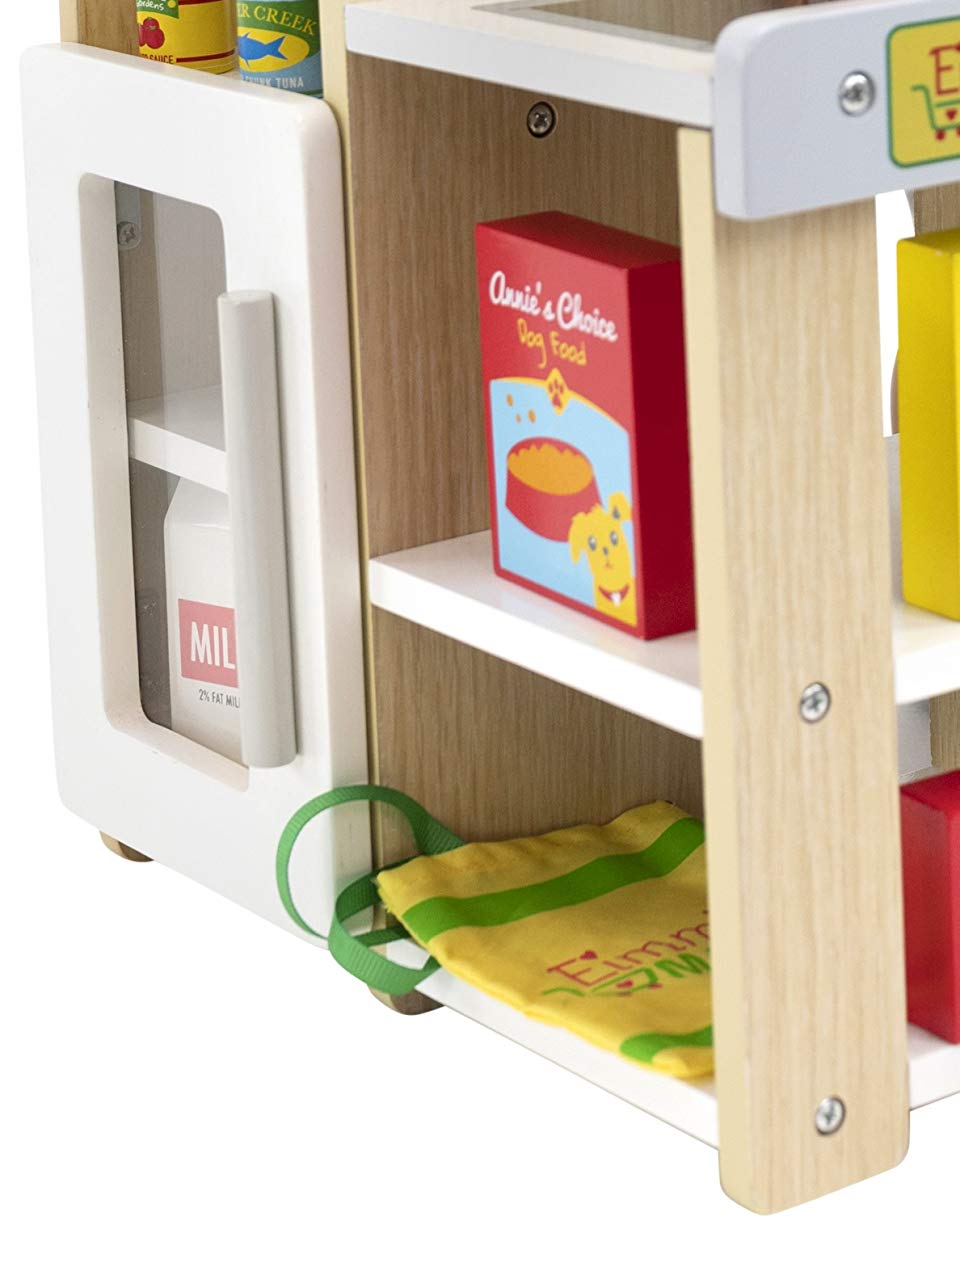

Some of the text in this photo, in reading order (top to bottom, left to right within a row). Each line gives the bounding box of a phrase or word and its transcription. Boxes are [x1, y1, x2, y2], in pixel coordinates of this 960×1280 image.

[254, 5, 317, 36] CREEK
[275, 76, 304, 89] TUNA
[489, 270, 619, 343] Annie's Choice
[517, 318, 587, 369] Dog Food
[191, 621, 236, 670] MIL
[212, 691, 224, 705] FAT
[226, 694, 240, 708] MIL
[546, 922, 709, 987] Eimm
